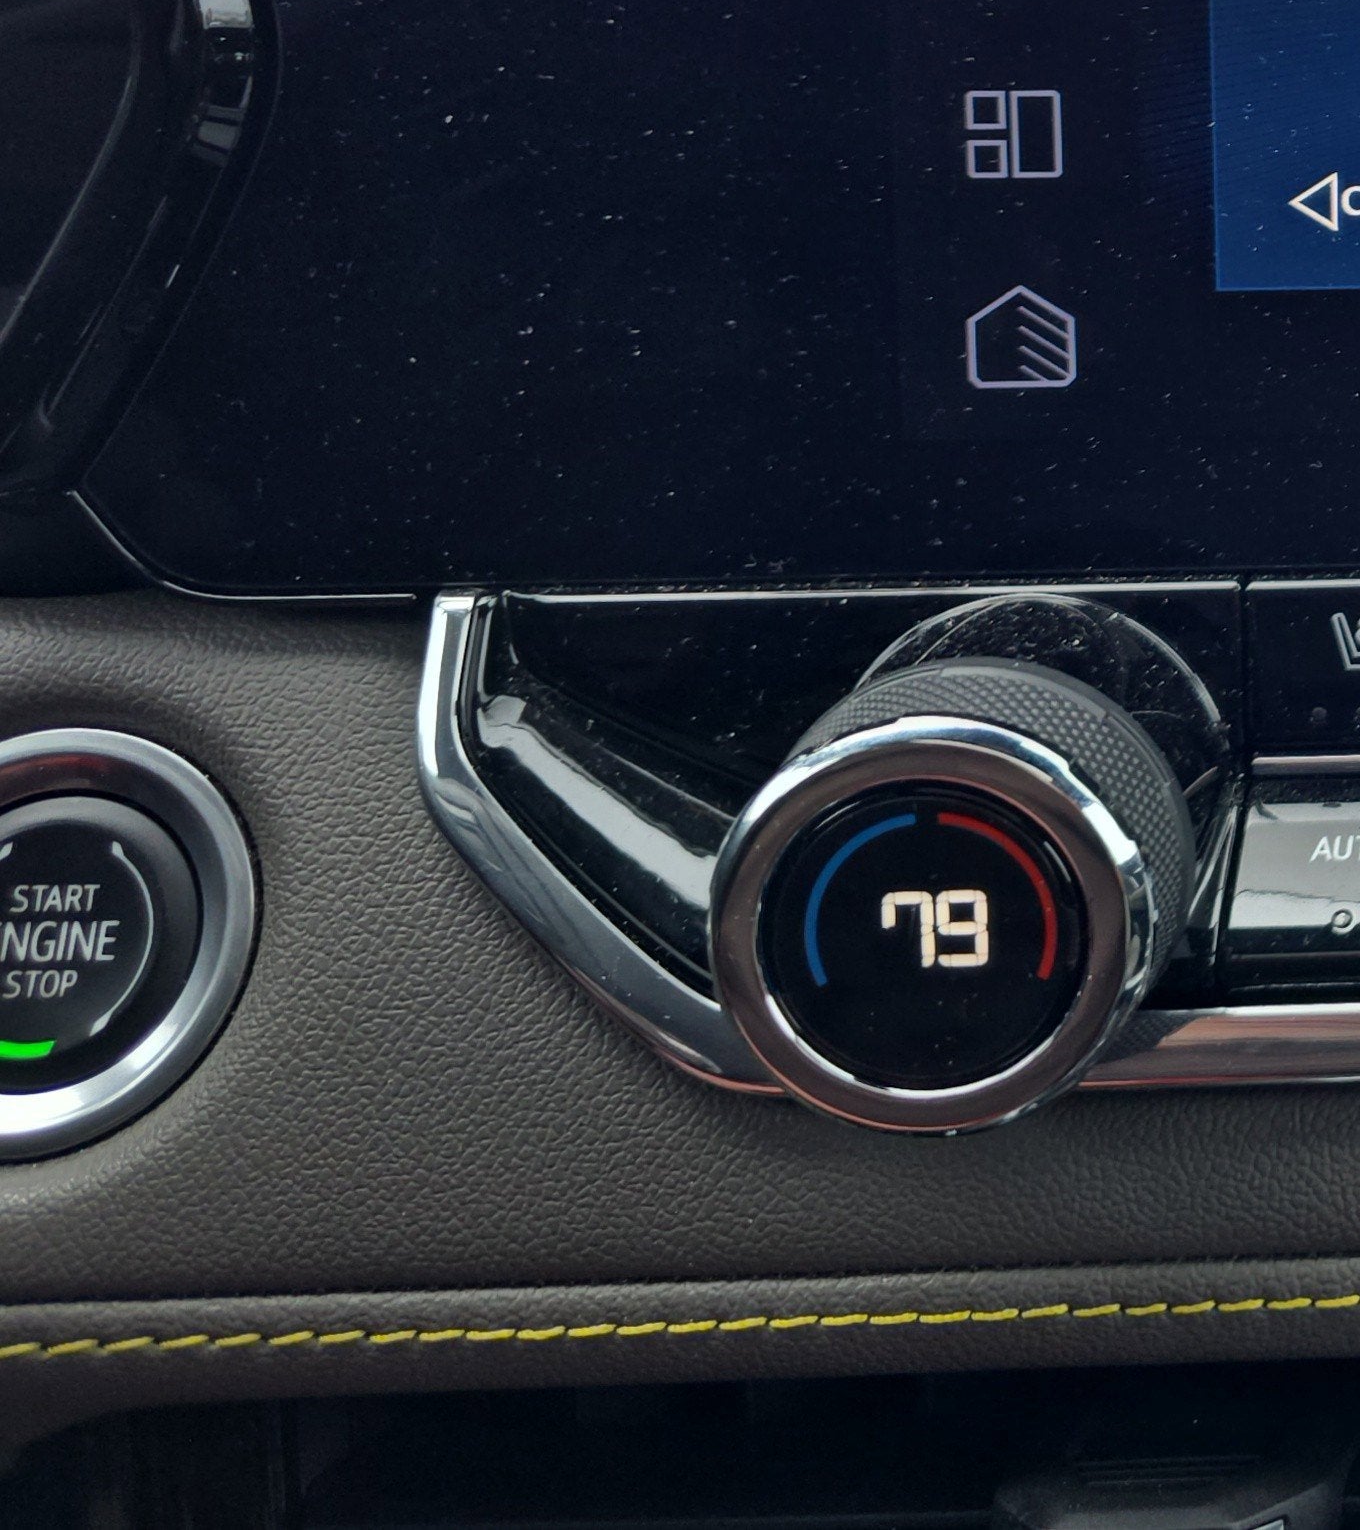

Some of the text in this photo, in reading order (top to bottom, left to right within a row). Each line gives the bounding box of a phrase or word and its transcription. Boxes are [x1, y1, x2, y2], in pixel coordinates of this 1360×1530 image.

[9, 884, 101, 913] START
[0, 920, 121, 964] NGINE
[880, 889, 990, 968] 79
[2, 970, 78, 999] STOP
